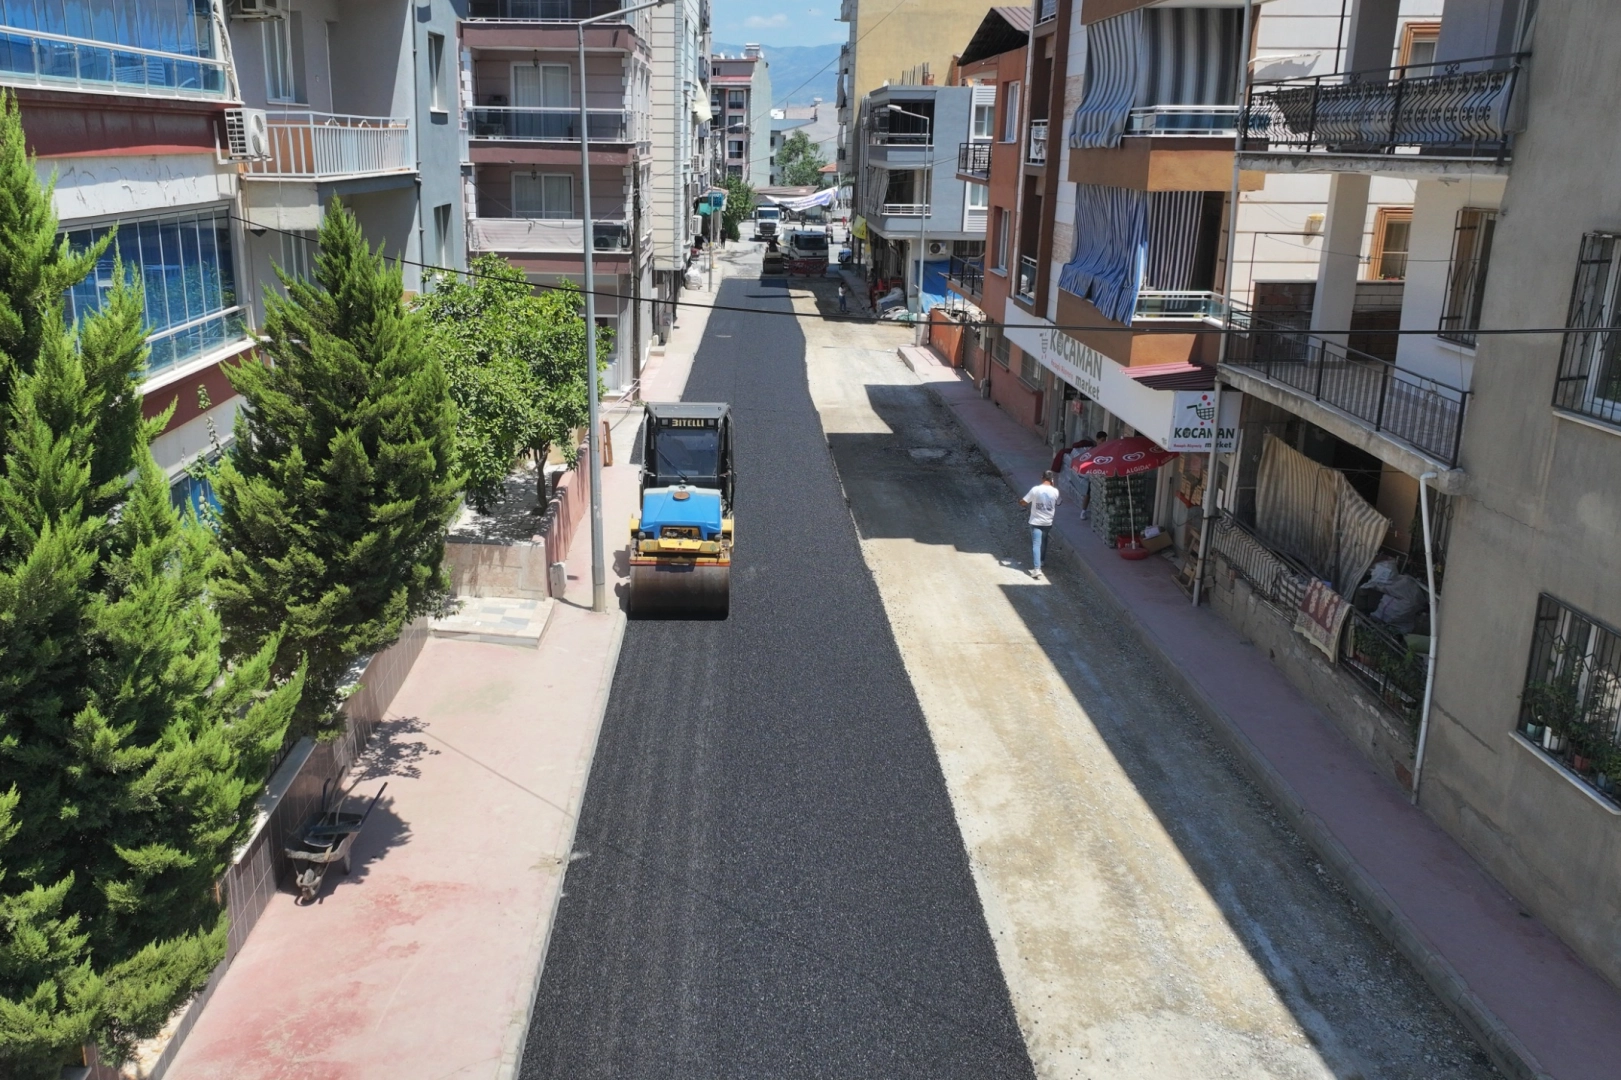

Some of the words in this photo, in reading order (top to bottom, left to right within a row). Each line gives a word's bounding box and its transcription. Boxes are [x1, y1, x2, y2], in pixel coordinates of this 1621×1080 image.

[1050, 327, 1103, 382] KOCAMAN
[1075, 375, 1100, 400] market
[671, 418, 705, 427] BITELLI
